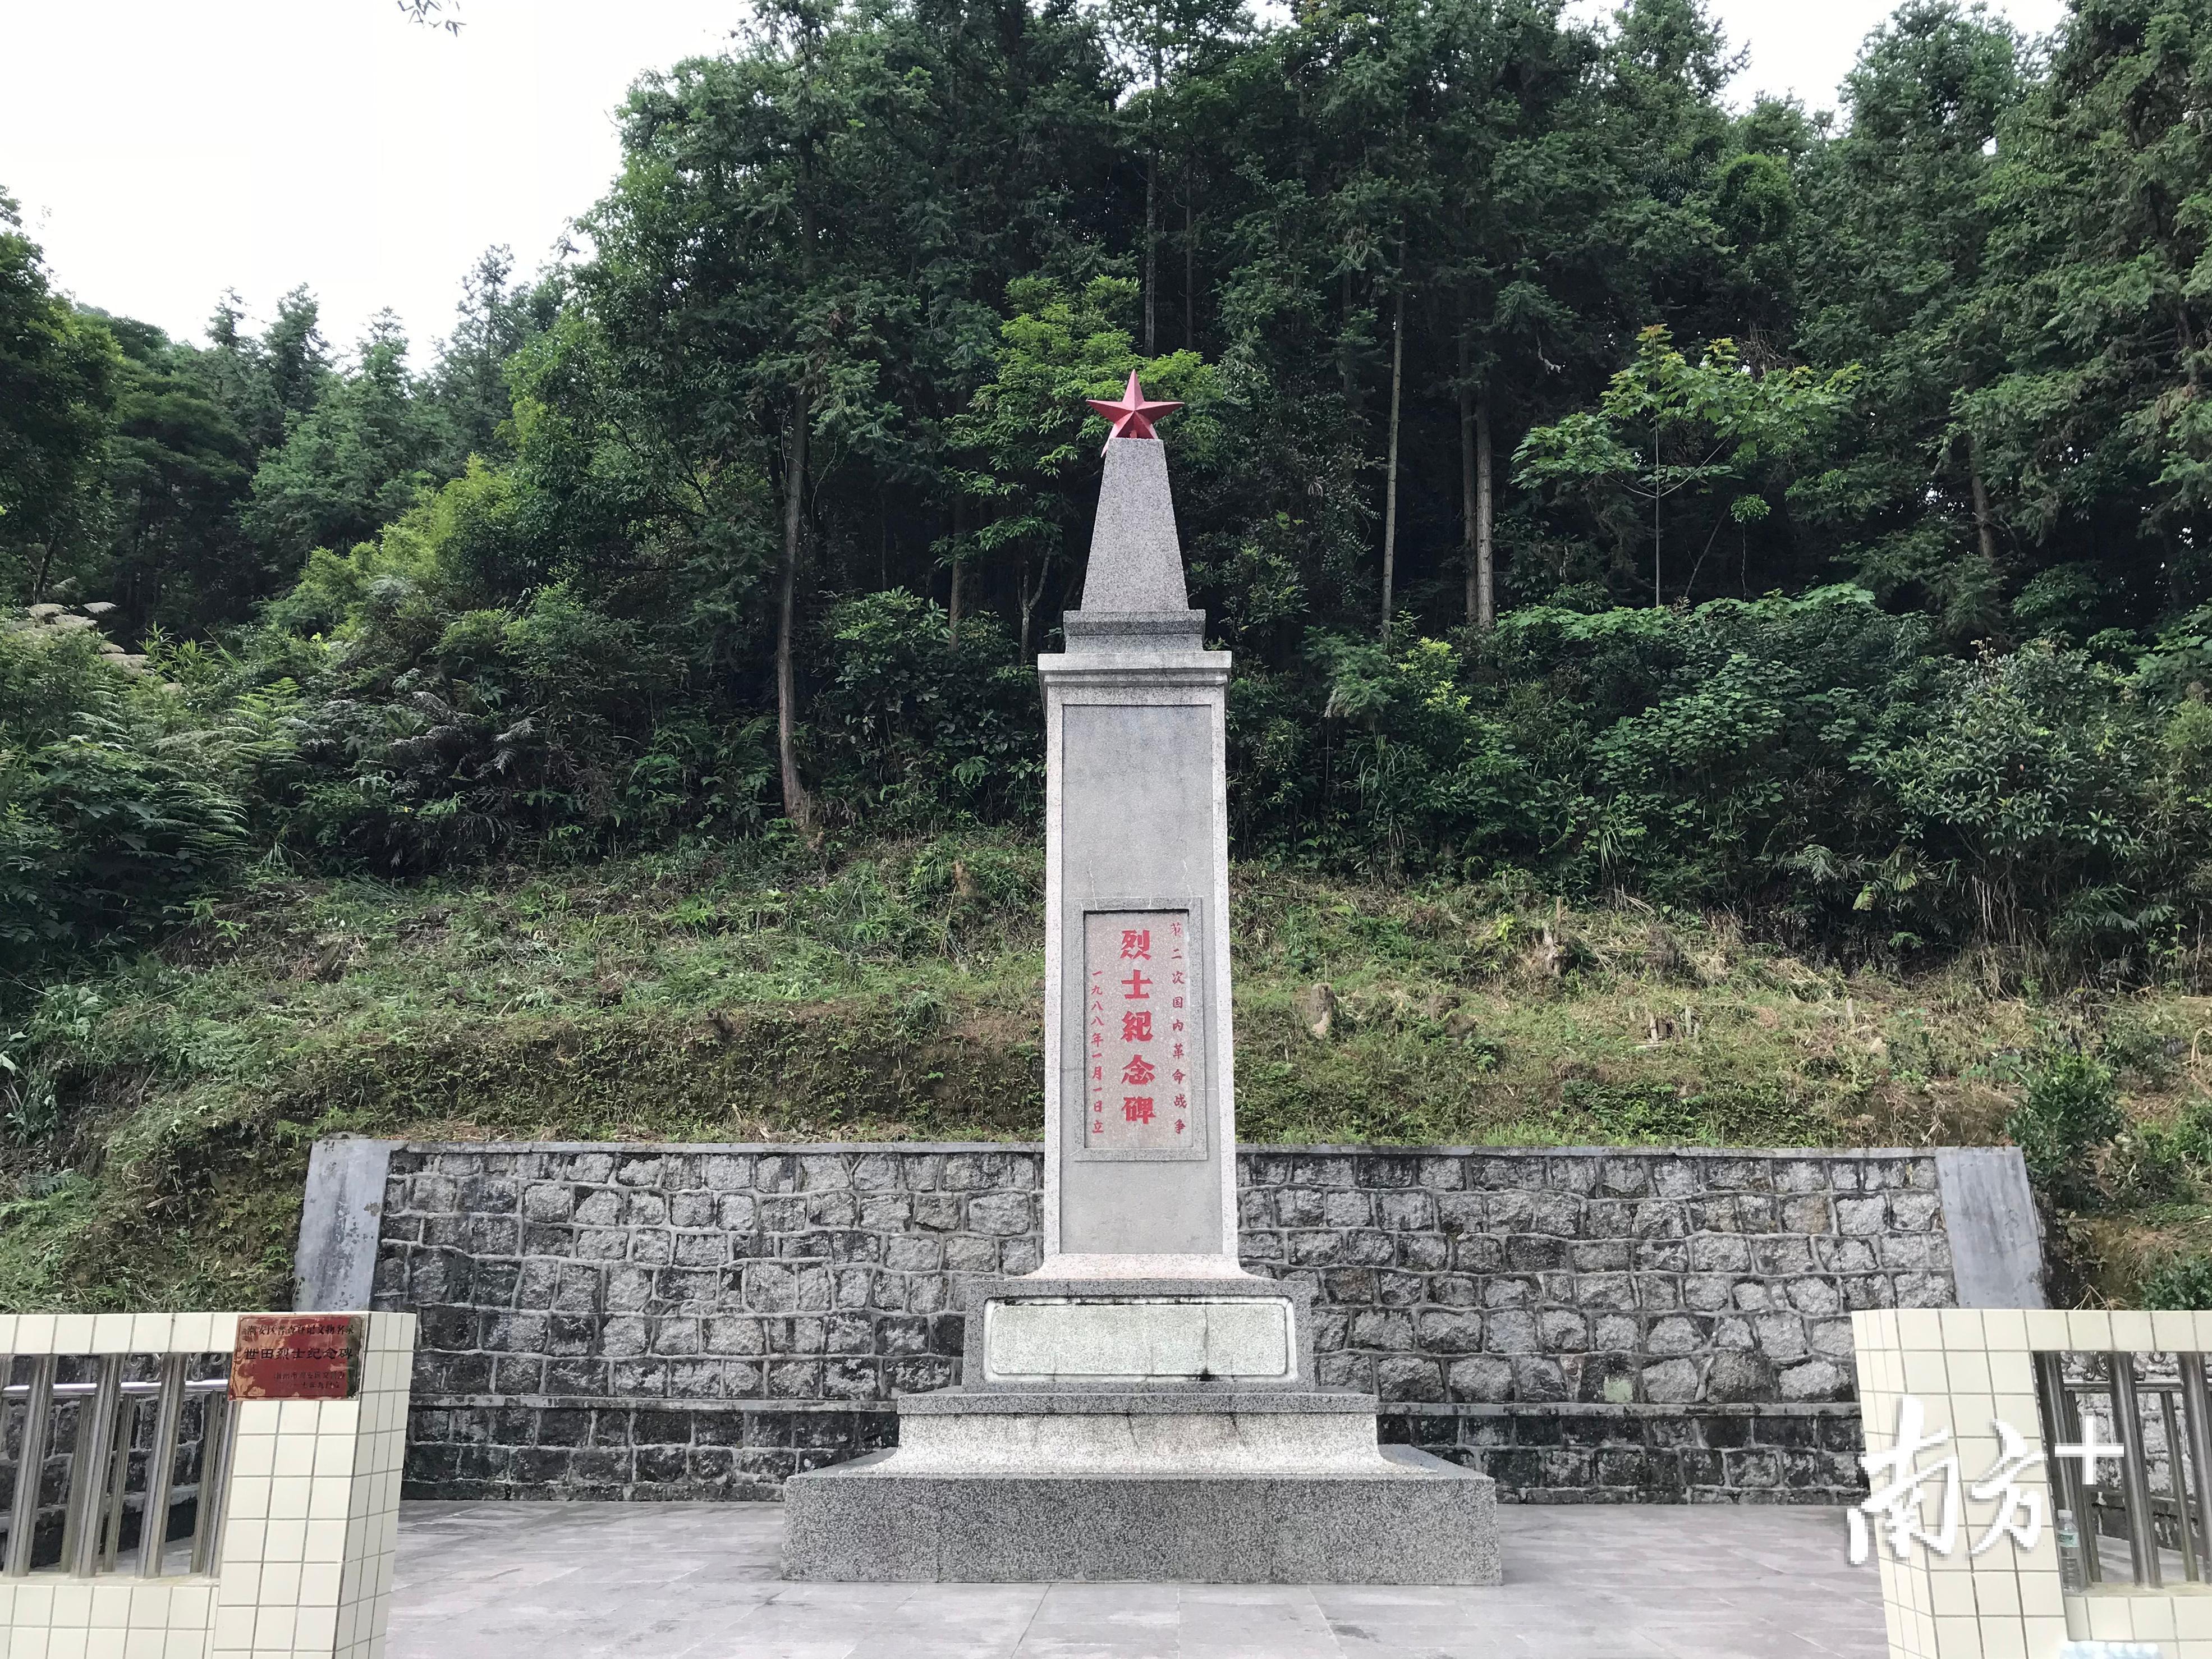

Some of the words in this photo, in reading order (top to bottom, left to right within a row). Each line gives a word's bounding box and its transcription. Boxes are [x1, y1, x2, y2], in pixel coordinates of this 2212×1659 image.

[1090, 970, 1105, 1134] 一九八八年一月一日立
[244, 1347, 354, 1360] 世田烈士纪念碑
